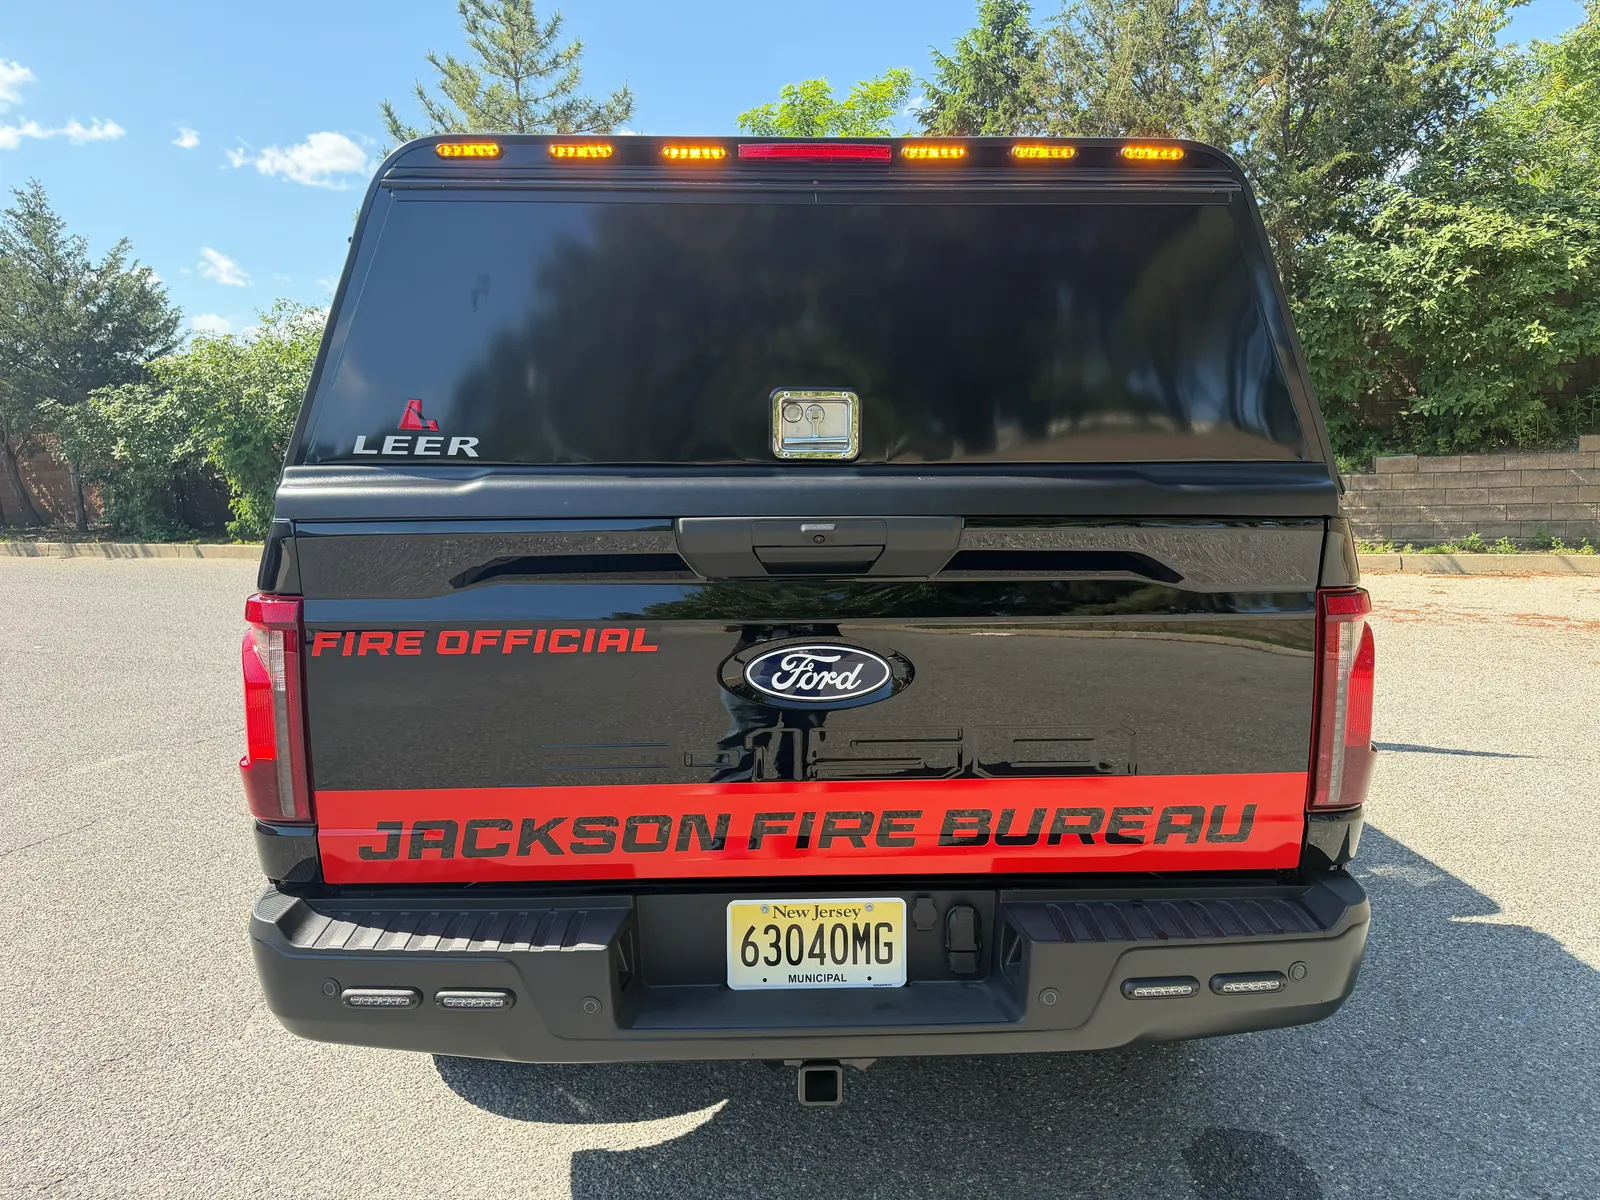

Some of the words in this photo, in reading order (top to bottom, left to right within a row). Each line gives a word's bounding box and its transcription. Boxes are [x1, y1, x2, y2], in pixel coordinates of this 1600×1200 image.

[353, 435, 480, 458] LEER
[311, 631, 426, 657] FIRE
[436, 628, 659, 655] OFFICIAL
[771, 654, 864, 690] Ford
[358, 812, 732, 861] JACKSON
[746, 809, 924, 850] FIRE
[936, 803, 1259, 848] BUREAU
[772, 905, 810, 920] New
[812, 904, 862, 922] Jersey
[740, 922, 894, 968] 63040MG
[787, 973, 848, 984] MUNICIPAL
